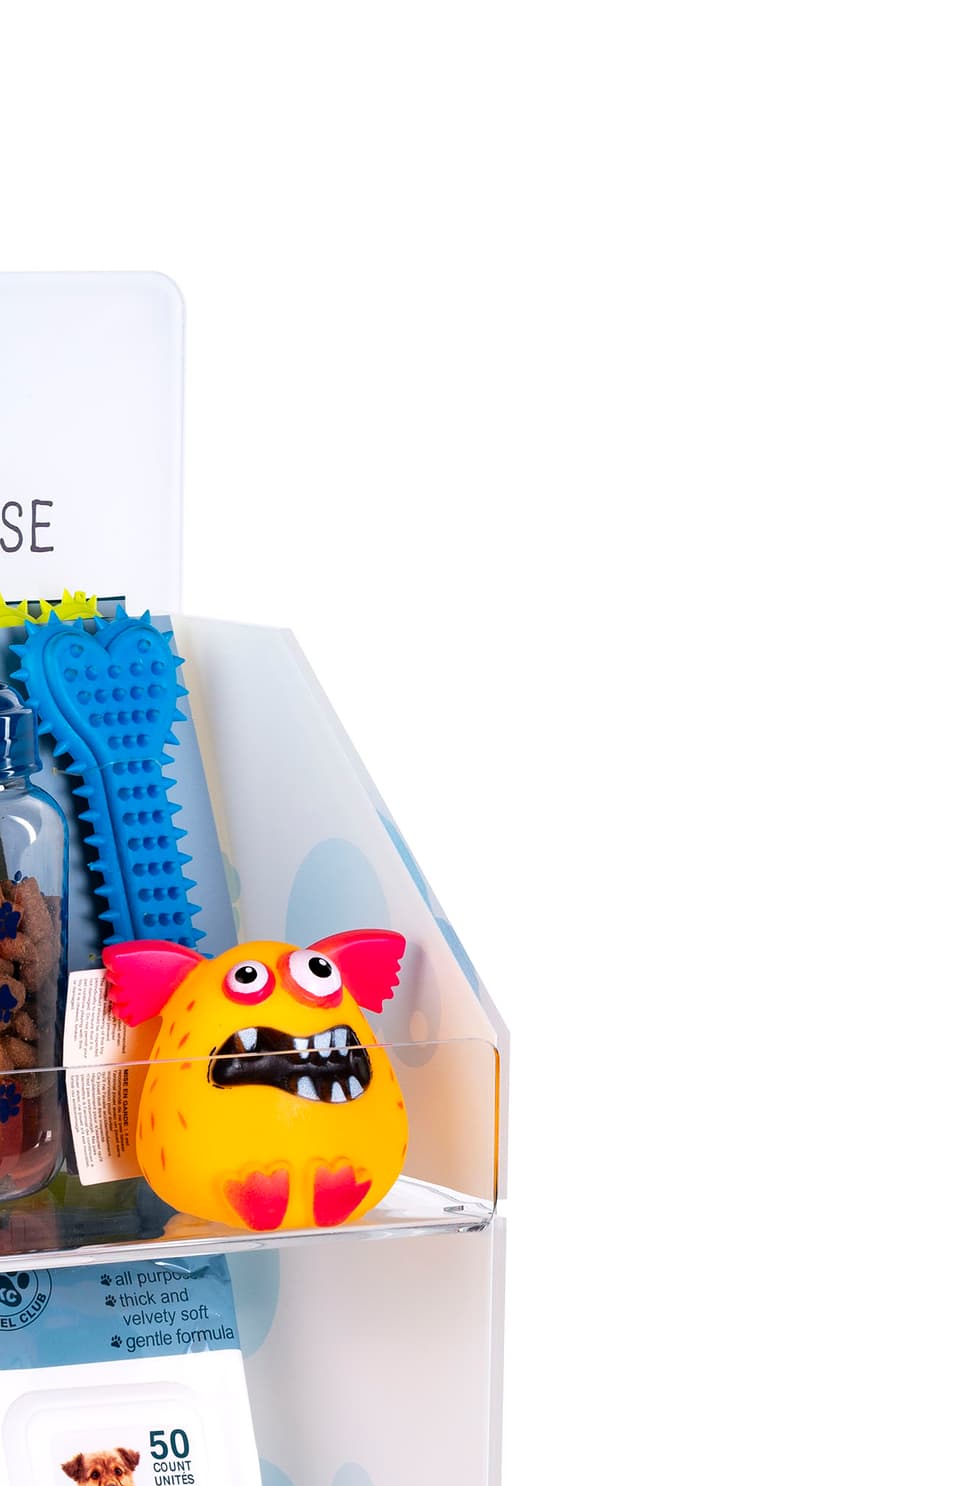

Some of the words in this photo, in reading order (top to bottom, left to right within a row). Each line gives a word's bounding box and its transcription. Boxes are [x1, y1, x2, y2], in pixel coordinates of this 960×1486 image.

[115, 1271, 133, 1286] all
[19, 1292, 47, 1323] CLUB
[120, 1291, 156, 1308] thick
[160, 1288, 189, 1303] and
[123, 1309, 176, 1326] velvety
[181, 1305, 209, 1321] soft
[126, 1330, 173, 1352] gentle
[176, 1325, 235, 1344] formula
[149, 1429, 190, 1460] 50
[153, 1460, 191, 1473] COUNT
[154, 1472, 195, 1486] UNITÉS
